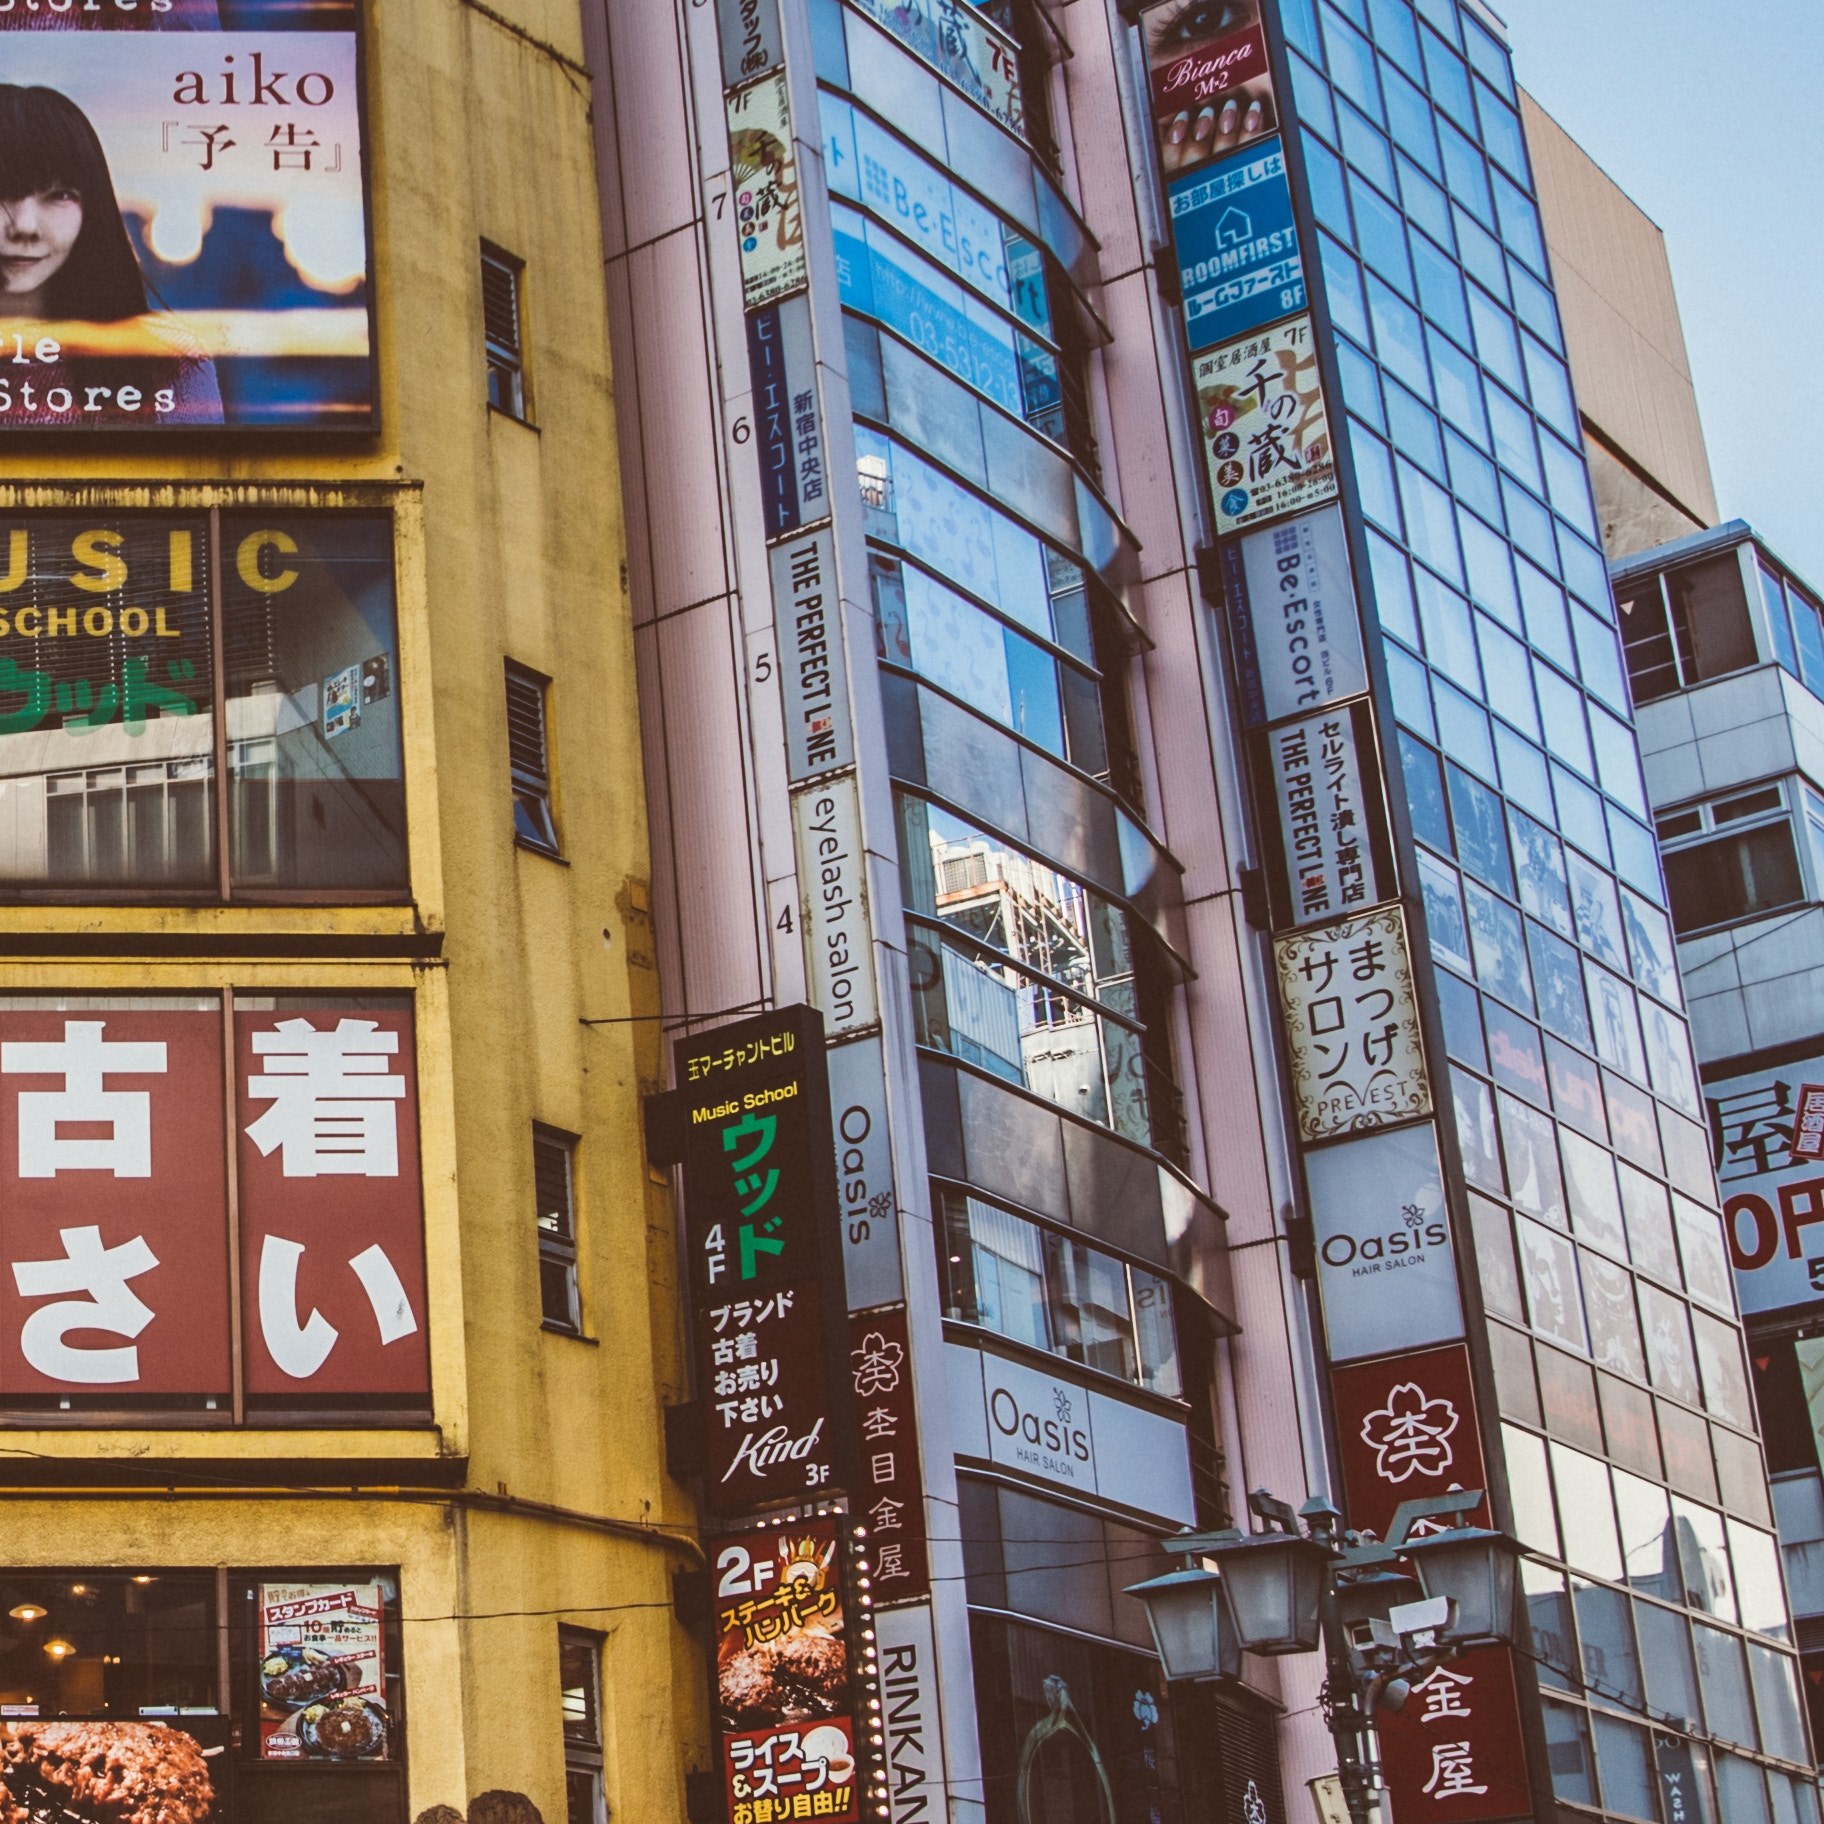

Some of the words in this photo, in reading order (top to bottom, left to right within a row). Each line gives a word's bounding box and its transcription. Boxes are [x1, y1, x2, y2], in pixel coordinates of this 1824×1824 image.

[173, 52, 336, 106] aiko
[1162, 41, 1253, 93] Bianca
[729, 90, 753, 114] 7F
[161, 122, 342, 173] 『予告』
[712, 192, 727, 221] 7
[1171, 155, 1284, 216] お部屋探しは
[1182, 226, 1295, 286] ROOMFIRST
[1281, 287, 1307, 311] 8F
[1198, 336, 1272, 379] 個室居酒屋
[1283, 326, 1309, 346] 7F
[731, 416, 752, 446] 6
[1237, 358, 1302, 484] 千の蔵
[792, 388, 823, 504] 新宿中央店
[790, 540, 821, 592] THE
[753, 654, 773, 684] 5
[794, 595, 834, 700] PERFECT
[1280, 728, 1307, 770] THE
[1284, 772, 1319, 866] PERFECT
[814, 797, 851, 924] eyelash
[776, 904, 794, 936] 4
[826, 931, 853, 1024] salon
[1299, 954, 1351, 1081] サロン
[1349, 939, 1399, 1068] まつげ
[692, 1096, 740, 1125] Music
[743, 1080, 798, 1111] School
[722, 1112, 786, 1281] ウッド
[838, 1105, 872, 1247] Oasis
[1321, 1222, 1448, 1268] Oasis
[1352, 1261, 1384, 1278] HAIR
[1386, 1254, 1425, 1274] SALON
[710, 1289, 795, 1334] ブランド
[712, 1333, 759, 1366] 古着
[714, 1361, 780, 1396] お売り
[714, 1393, 784, 1428] 下さい
[989, 1386, 1091, 1464] Oasis
[721, 1416, 825, 1484] Kind
[805, 1461, 830, 1487] 3F
[1016, 1447, 1043, 1468] HAIR
[1044, 1453, 1076, 1479] SALON
[716, 1545, 775, 1598] 2F
[744, 1590, 838, 1651] ハンバーグ
[729, 1731, 806, 1771] ライス
[732, 1756, 828, 1799] &スープ
